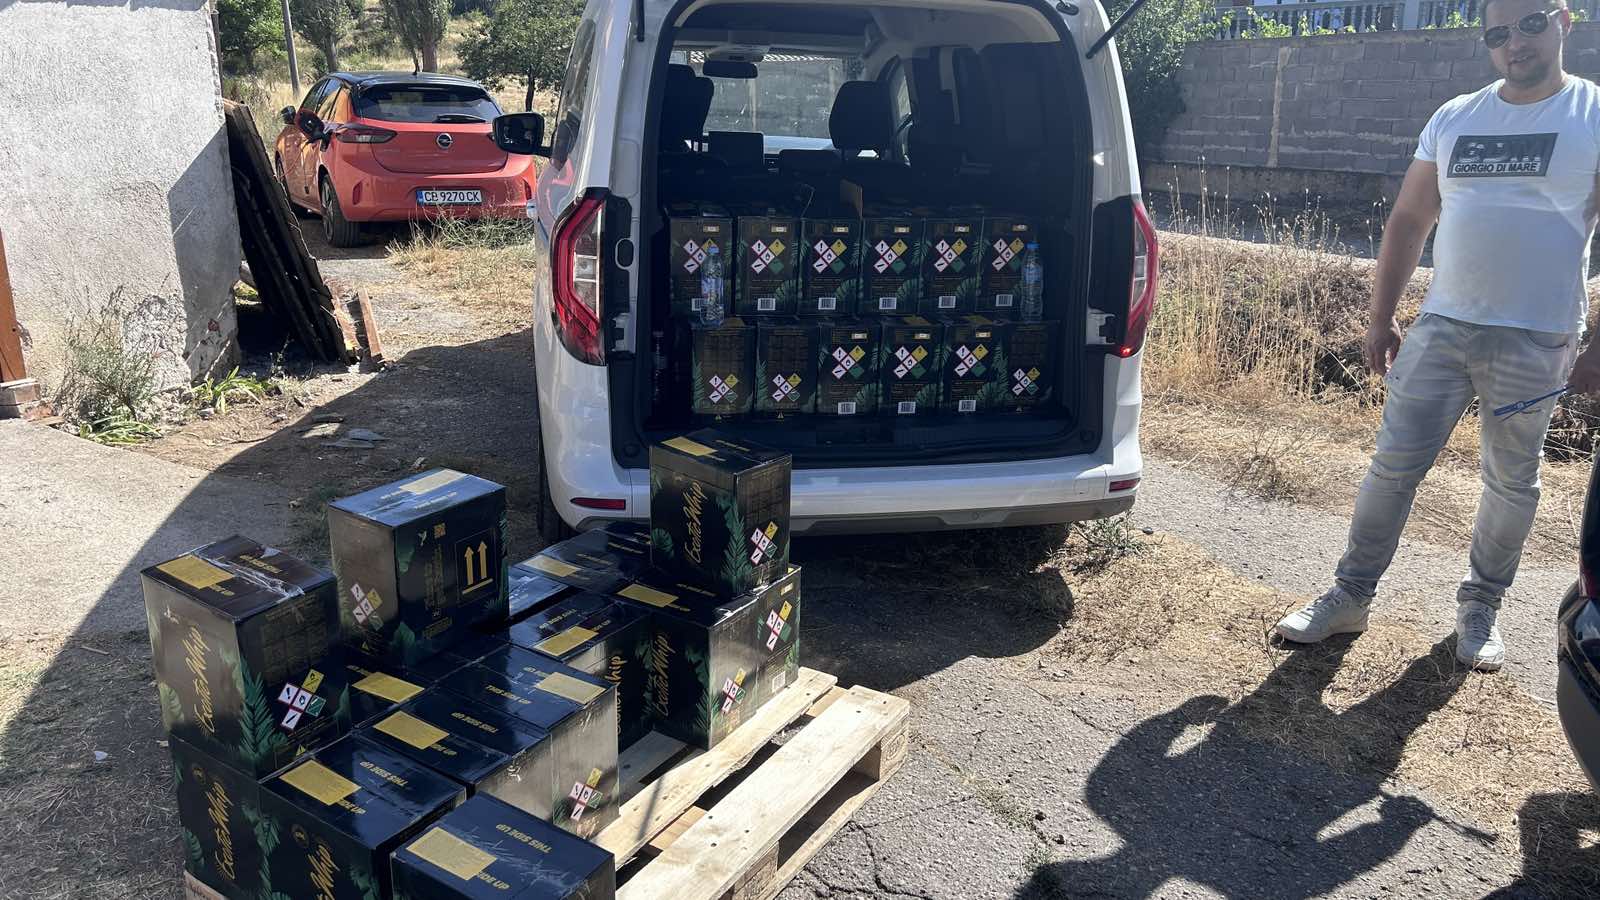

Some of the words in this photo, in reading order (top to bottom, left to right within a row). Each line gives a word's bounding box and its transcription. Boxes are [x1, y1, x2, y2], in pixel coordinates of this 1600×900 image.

[1454, 163, 1494, 173] GIORGIO
[1496, 163, 1506, 172] DI
[1509, 162, 1538, 172] MARE
[424, 191, 439, 202] CB
[440, 191, 465, 202] 9270
[466, 191, 480, 202] CK
[359, 760, 374, 769] UP
[370, 765, 393, 779] SIDE
[386, 773, 409, 787] THIS
[495, 823, 511, 833] UP
[508, 830, 533, 843] SIDE
[527, 839, 553, 854] THIS
[491, 879, 510, 890] UP
